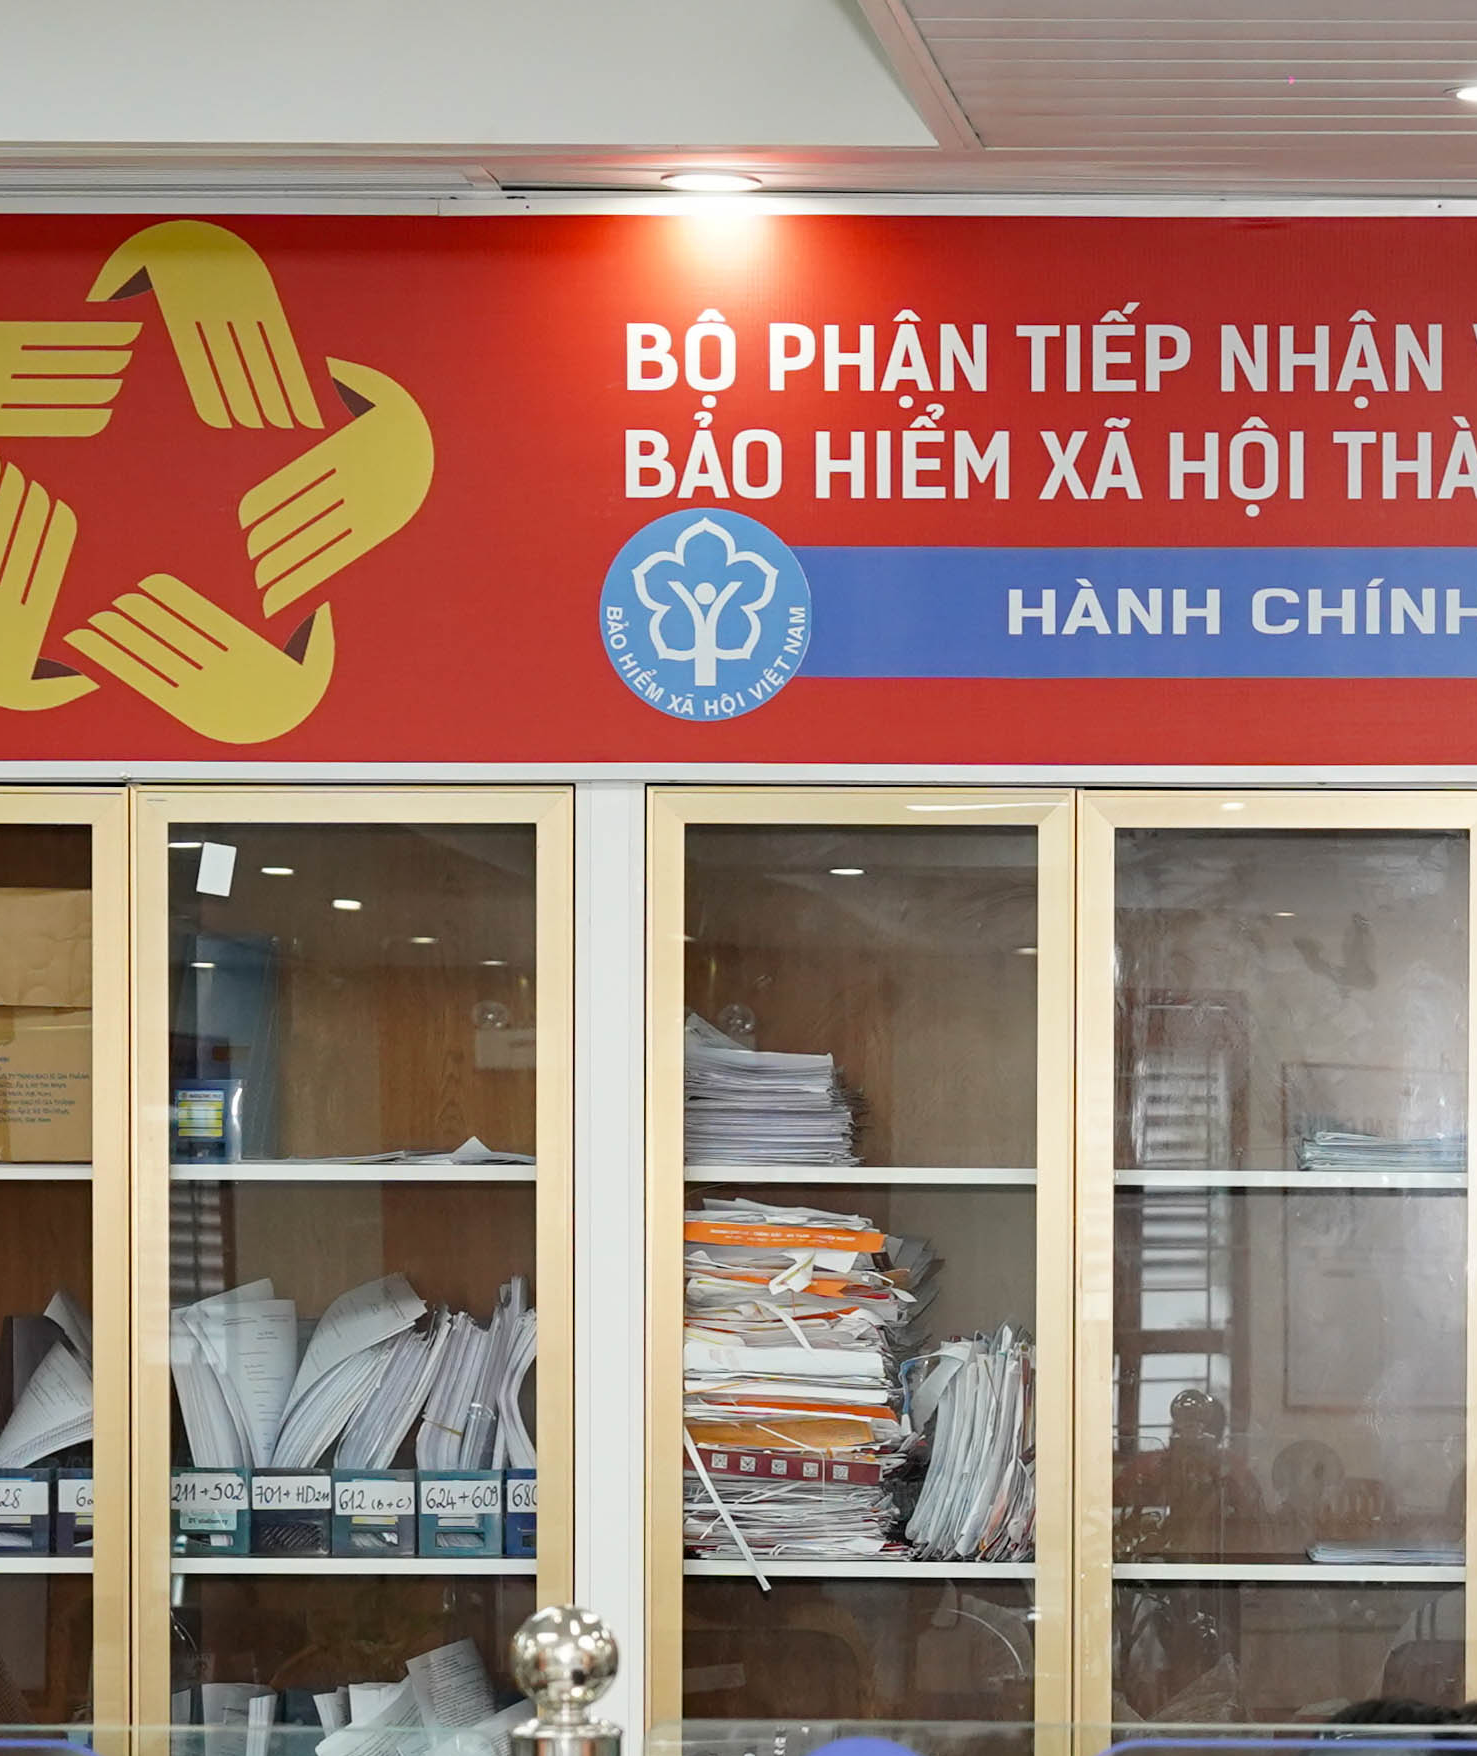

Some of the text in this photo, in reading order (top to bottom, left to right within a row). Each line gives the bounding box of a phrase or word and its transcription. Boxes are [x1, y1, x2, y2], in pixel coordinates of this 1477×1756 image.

[625, 308, 737, 409] BỘ
[769, 309, 988, 409] PHẬN
[1015, 301, 1191, 393] TIẾP
[1220, 309, 1443, 409] NHẬN
[624, 410, 783, 501] BẢO
[815, 403, 1012, 501] HIỂM
[1038, 415, 1143, 501] XÃ
[1169, 415, 1305, 518] HỘI
[1007, 577, 1222, 636] HÀNH
[605, 605, 807, 717] BẢO HIỂM XÃ HỘI VIỆT NAM
[339, 1489, 366, 1511] 612
